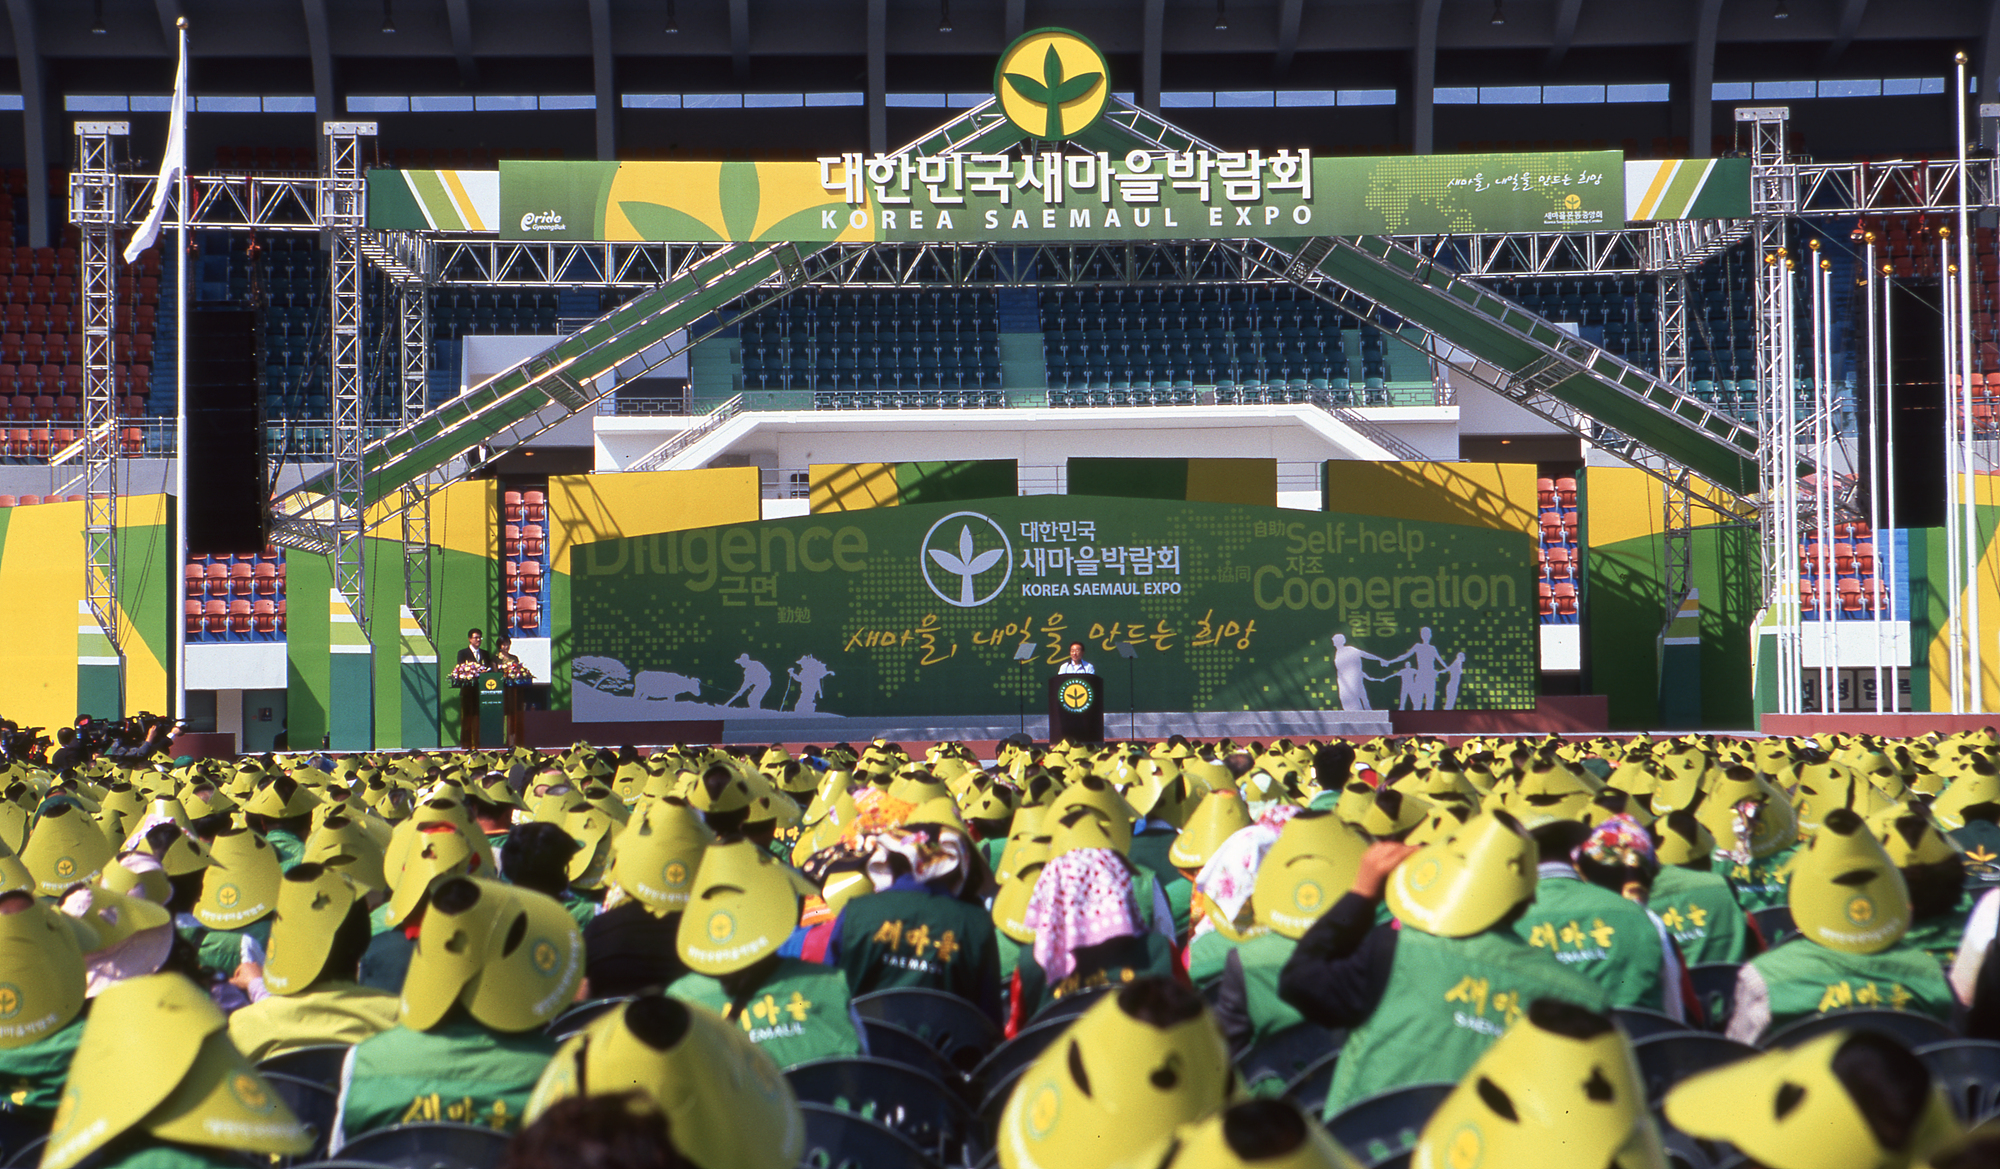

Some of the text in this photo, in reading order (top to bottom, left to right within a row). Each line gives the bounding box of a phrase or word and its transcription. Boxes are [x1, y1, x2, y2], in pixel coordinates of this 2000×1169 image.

[816, 148, 1312, 204] 대한민국새마을박람회
[1447, 169, 1603, 192] 새마을, 내일을 만드는 희망
[820, 205, 1312, 230] KOREA SAEMAUL EXPO
[1020, 520, 1096, 542] 대한민국
[1286, 522, 1425, 561] Self-help
[586, 524, 869, 592] Diligence
[1020, 545, 1181, 577] 새마을박람회
[1286, 555, 1324, 575] 자조
[719, 572, 780, 607] 근면
[1021, 581, 1182, 598] KOREA SAEMAUL EXPO
[1253, 564, 1516, 622] Cooperation
[844, 613, 957, 665] 새마을,
[1089, 622, 1177, 651] 만드는
[1192, 609, 1257, 650] 희망
[1348, 611, 1398, 637] 협동
[1662, 903, 1708, 932] 마을
[873, 919, 960, 963] 새마을
[1529, 918, 1615, 953] 새마을
